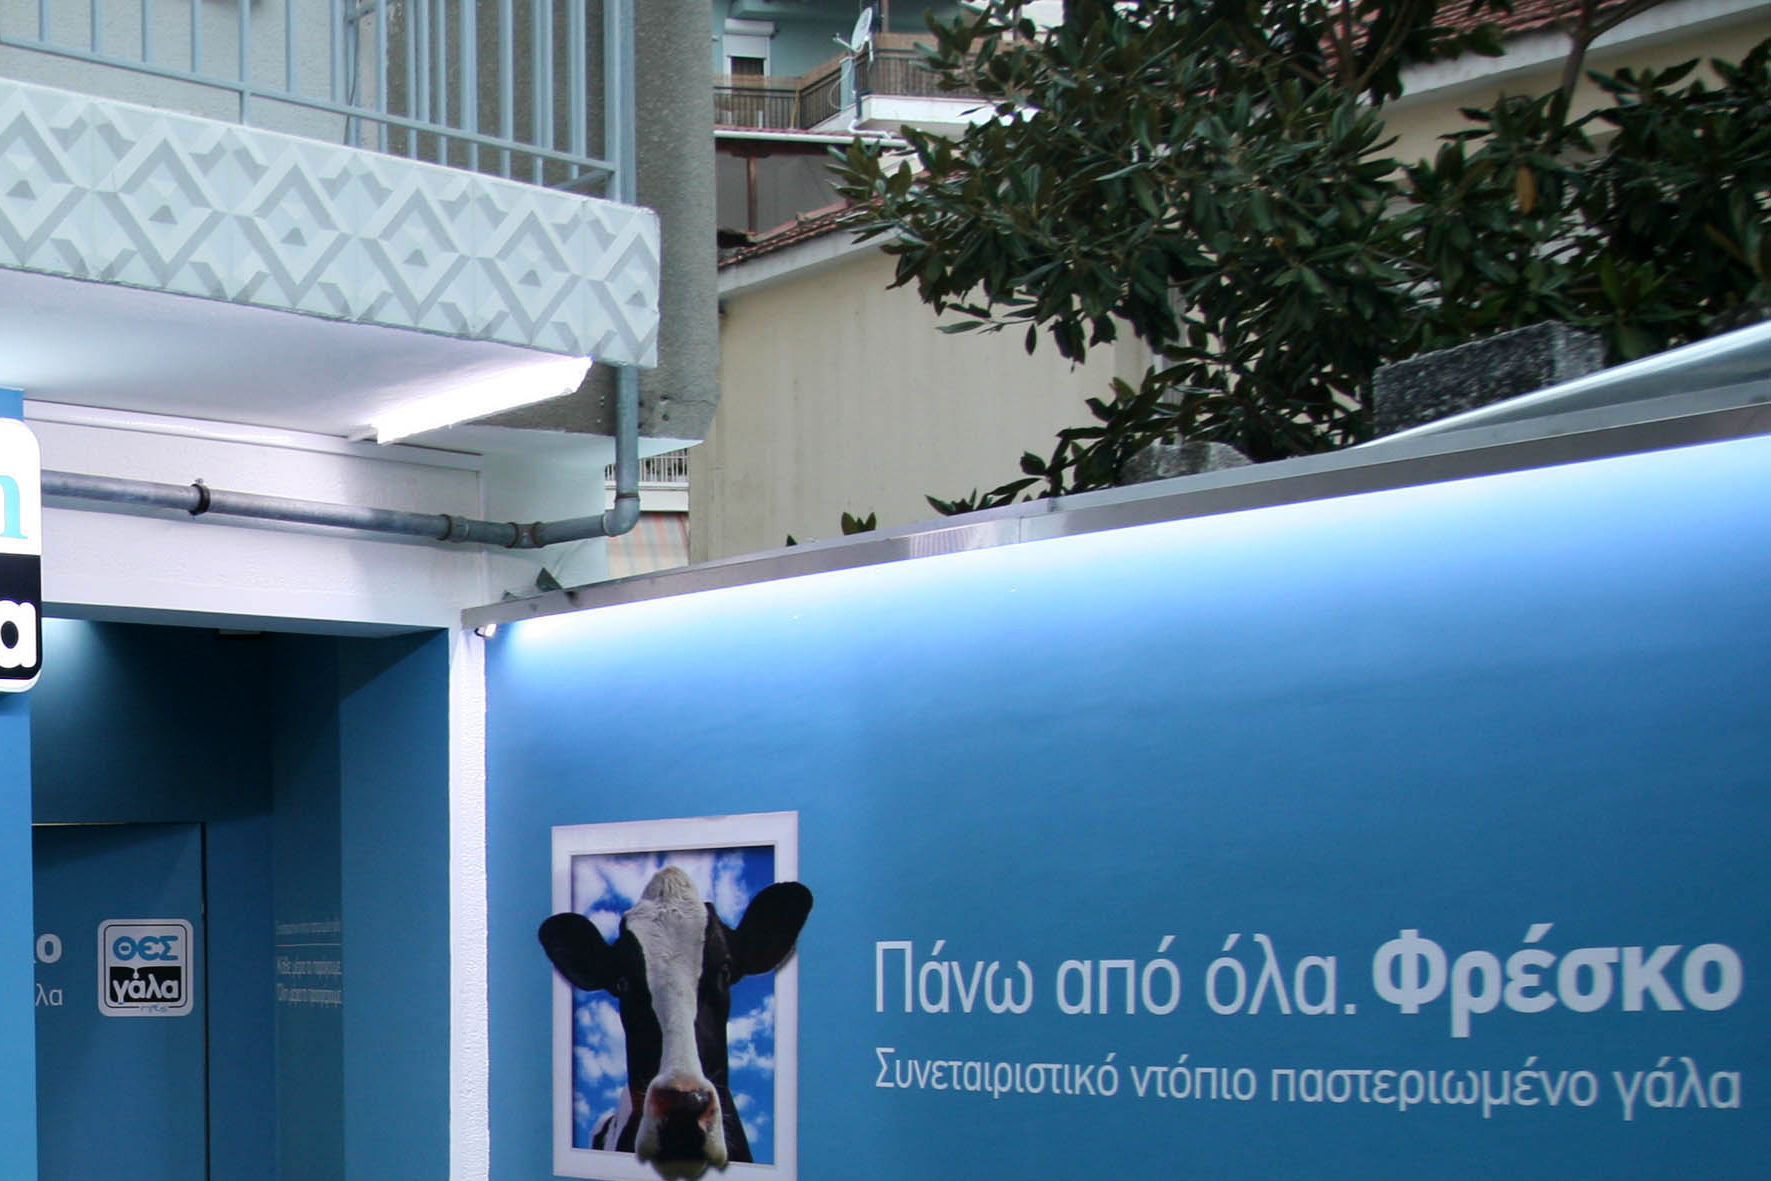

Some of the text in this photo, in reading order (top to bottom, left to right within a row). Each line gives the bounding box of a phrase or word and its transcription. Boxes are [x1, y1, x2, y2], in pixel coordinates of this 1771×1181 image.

[111, 968, 180, 1003] γάλα
[875, 922, 1744, 1038] Πάνω από όλα. Φρέσκο
[875, 1047, 1742, 1121] Συνεταιριστικό ντόπιο παστεριωμένο γάλα
